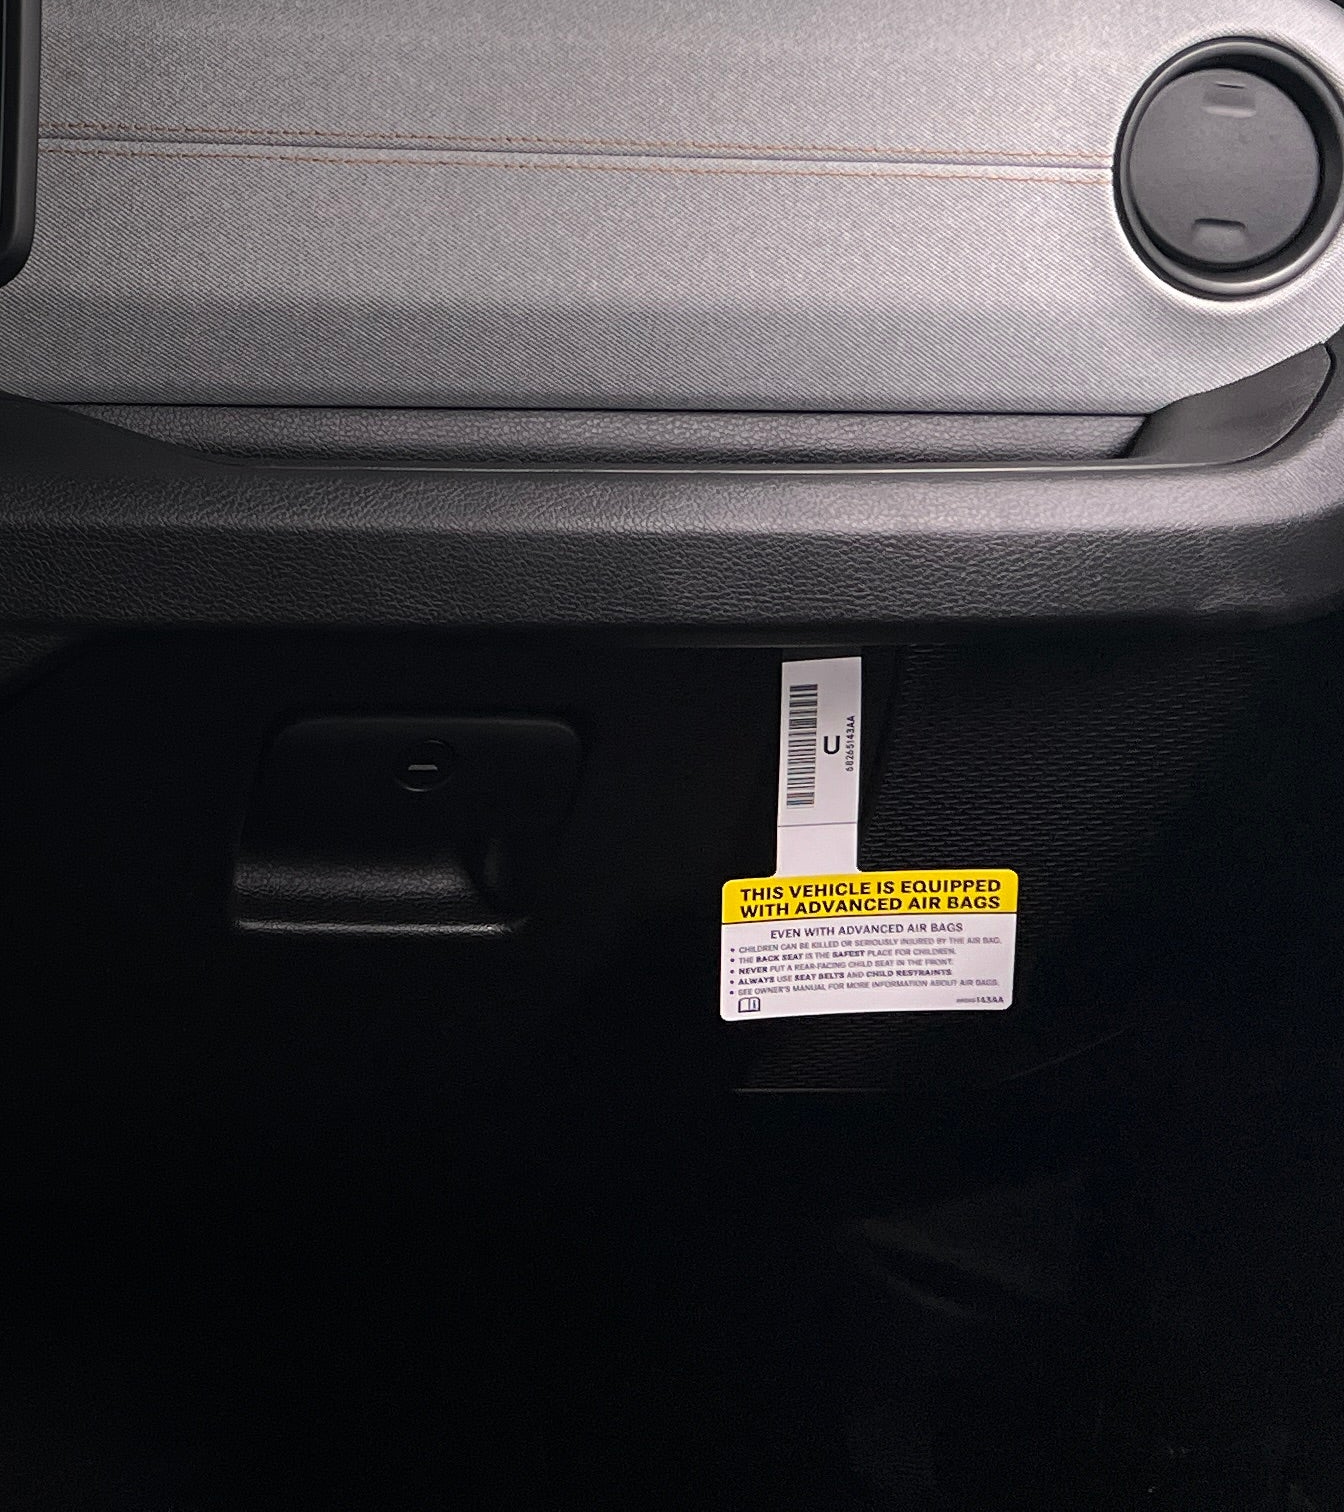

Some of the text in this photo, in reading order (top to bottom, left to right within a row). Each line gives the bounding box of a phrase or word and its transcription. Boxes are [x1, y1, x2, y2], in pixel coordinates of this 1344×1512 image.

[824, 735, 840, 755] U
[740, 879, 1001, 902] THIS VEHICLE IS EQUIPPED
[740, 895, 1000, 919] WITH ADVANCED AIR BAGS
[771, 923, 963, 939] EVEN WITH ADVANCED AIR BAGS
